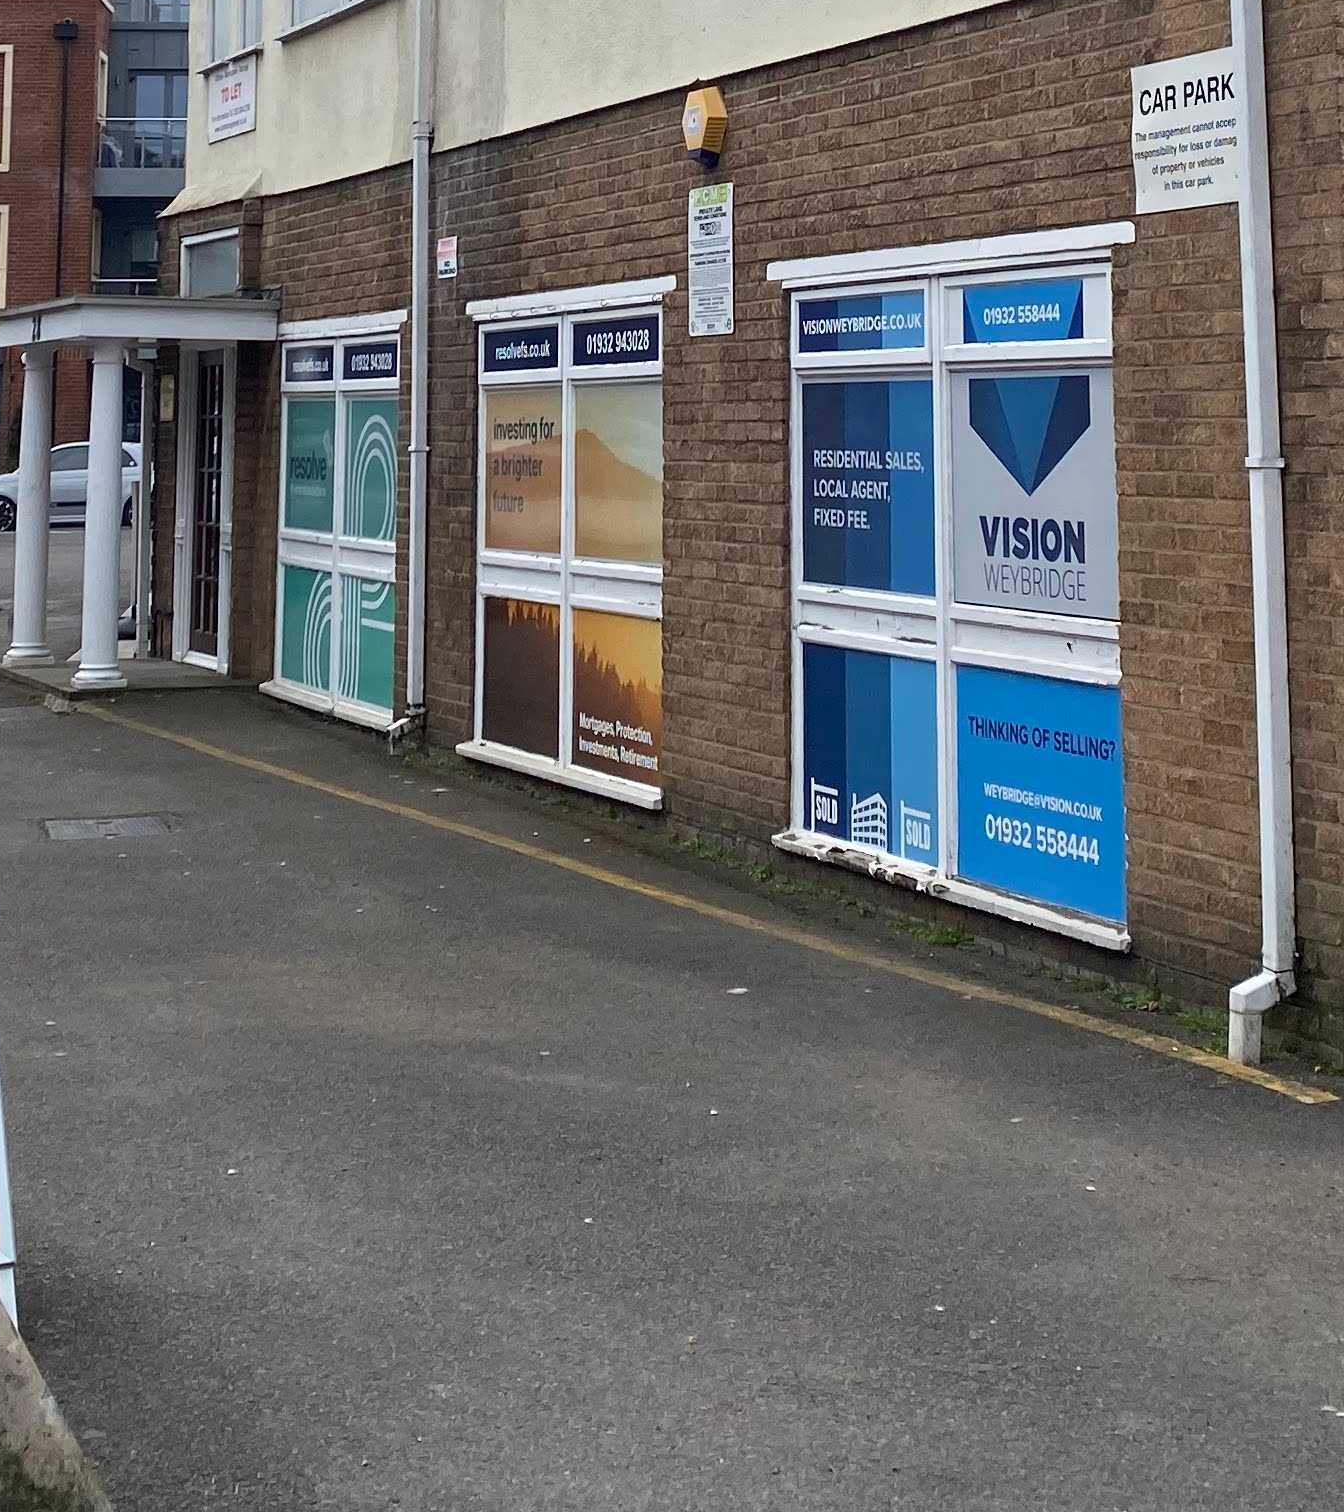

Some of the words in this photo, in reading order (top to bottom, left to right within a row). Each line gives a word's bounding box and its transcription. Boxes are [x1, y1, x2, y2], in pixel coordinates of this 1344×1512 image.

[1140, 84, 1177, 116] CAR
[1184, 72, 1235, 108] PARK
[1216, 117, 1236, 129] accep
[1214, 136, 1237, 147] damag
[802, 312, 921, 336] VISIONWEYBRIDGE.CO.UK
[983, 305, 1016, 326] 01932
[1017, 303, 1060, 324] 558444
[586, 332, 613, 355] 01932
[615, 329, 650, 352] 943028
[493, 417, 537, 444] investing
[539, 416, 554, 440] for
[493, 459, 501, 477] a
[501, 454, 543, 481] brighter
[813, 449, 883, 470] RESIDENTIAL
[885, 451, 925, 474] SALES,
[493, 489, 524, 514] future
[813, 479, 849, 499] LOCAL
[850, 481, 891, 503] AGENT,
[814, 508, 845, 528] FIXED
[847, 510, 871, 530] FEE.
[979, 515, 1086, 564] VISION
[984, 563, 1087, 602] WEYBRIDGE
[968, 716, 1029, 745] THINKING
[1032, 727, 1051, 749] OF
[1054, 731, 1116, 761] SELLING?
[815, 793, 838, 825] SOLD
[906, 818, 930, 851] SOLD
[985, 813, 1032, 849] 01932
[1036, 825, 1099, 865] 558444
